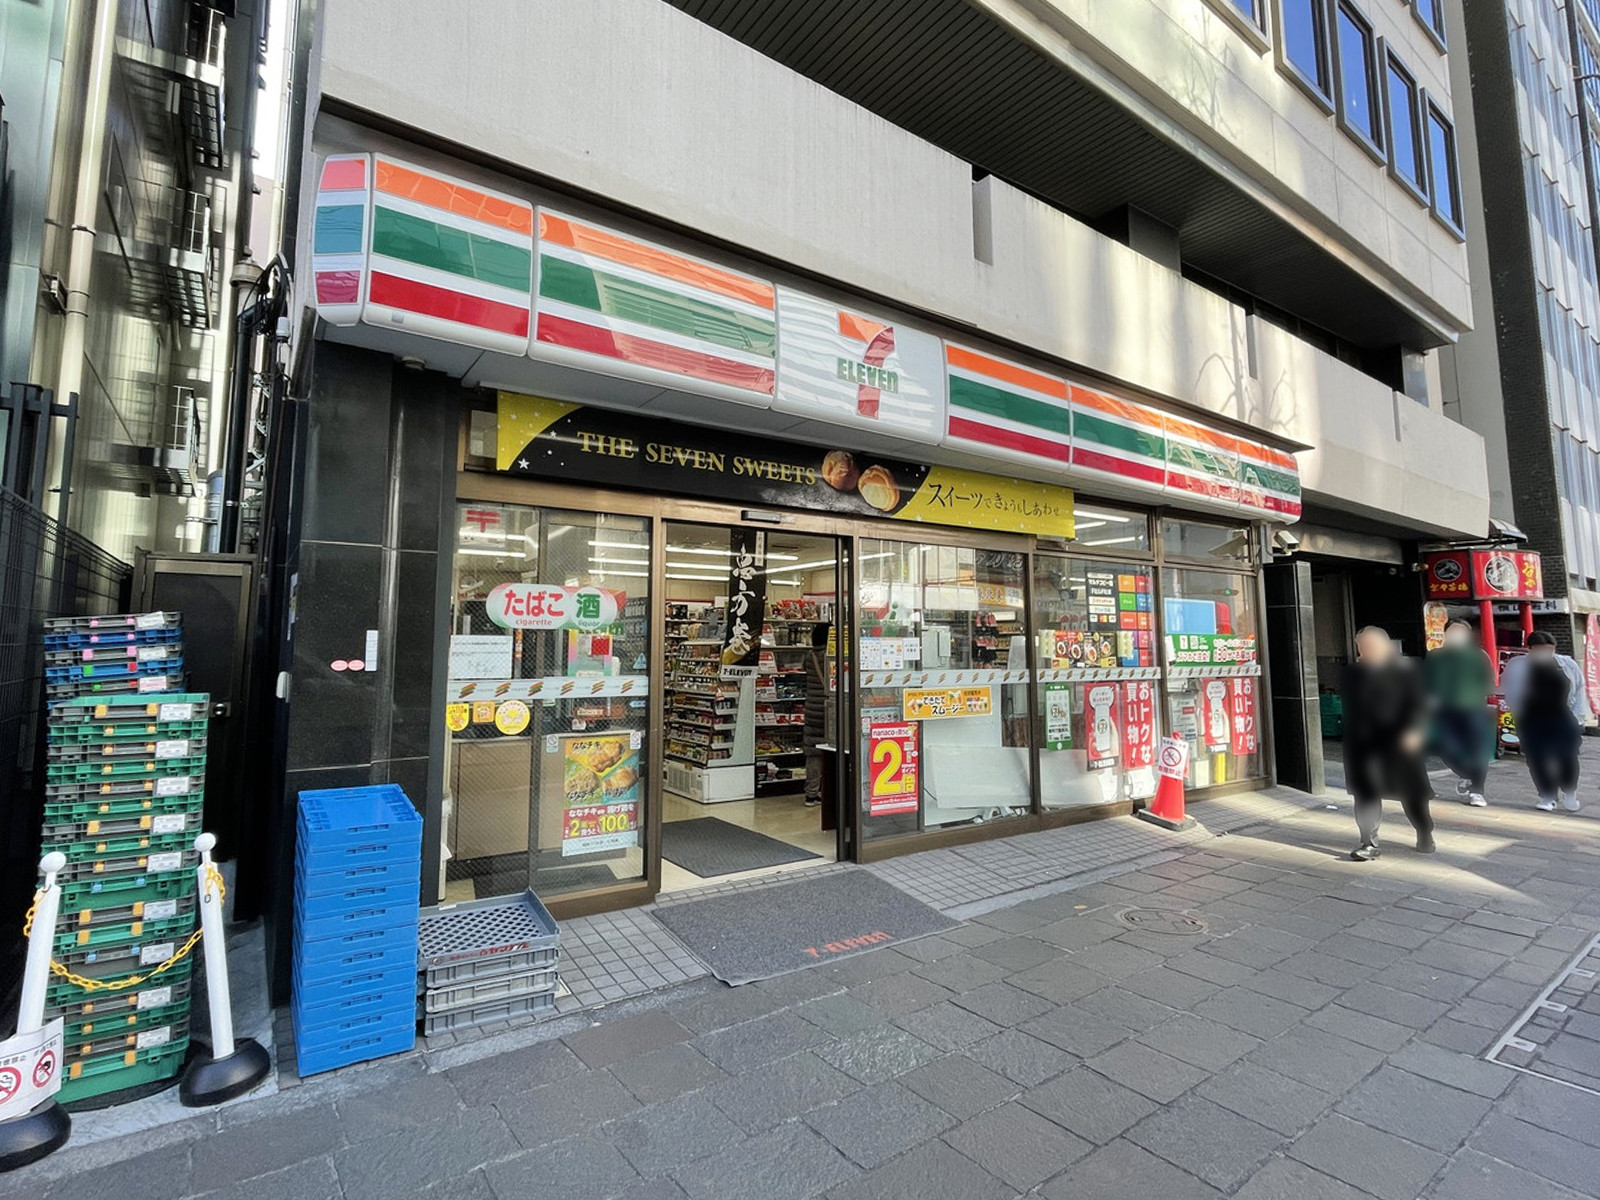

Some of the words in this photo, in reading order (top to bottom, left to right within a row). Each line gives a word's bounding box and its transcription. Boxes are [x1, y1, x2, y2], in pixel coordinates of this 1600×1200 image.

[577, 431, 635, 459] THE
[645, 443, 725, 473] SEVEN
[732, 456, 817, 486] SWEETS
[503, 589, 565, 618] たばこ
[575, 593, 601, 619] 酒
[515, 618, 553, 627] cigarette
[577, 619, 600, 628] liquor
[931, 703, 965, 716] スムージー
[1139, 681, 1152, 764] おトクな
[1243, 678, 1255, 751] おトクな
[872, 739, 903, 797] 2
